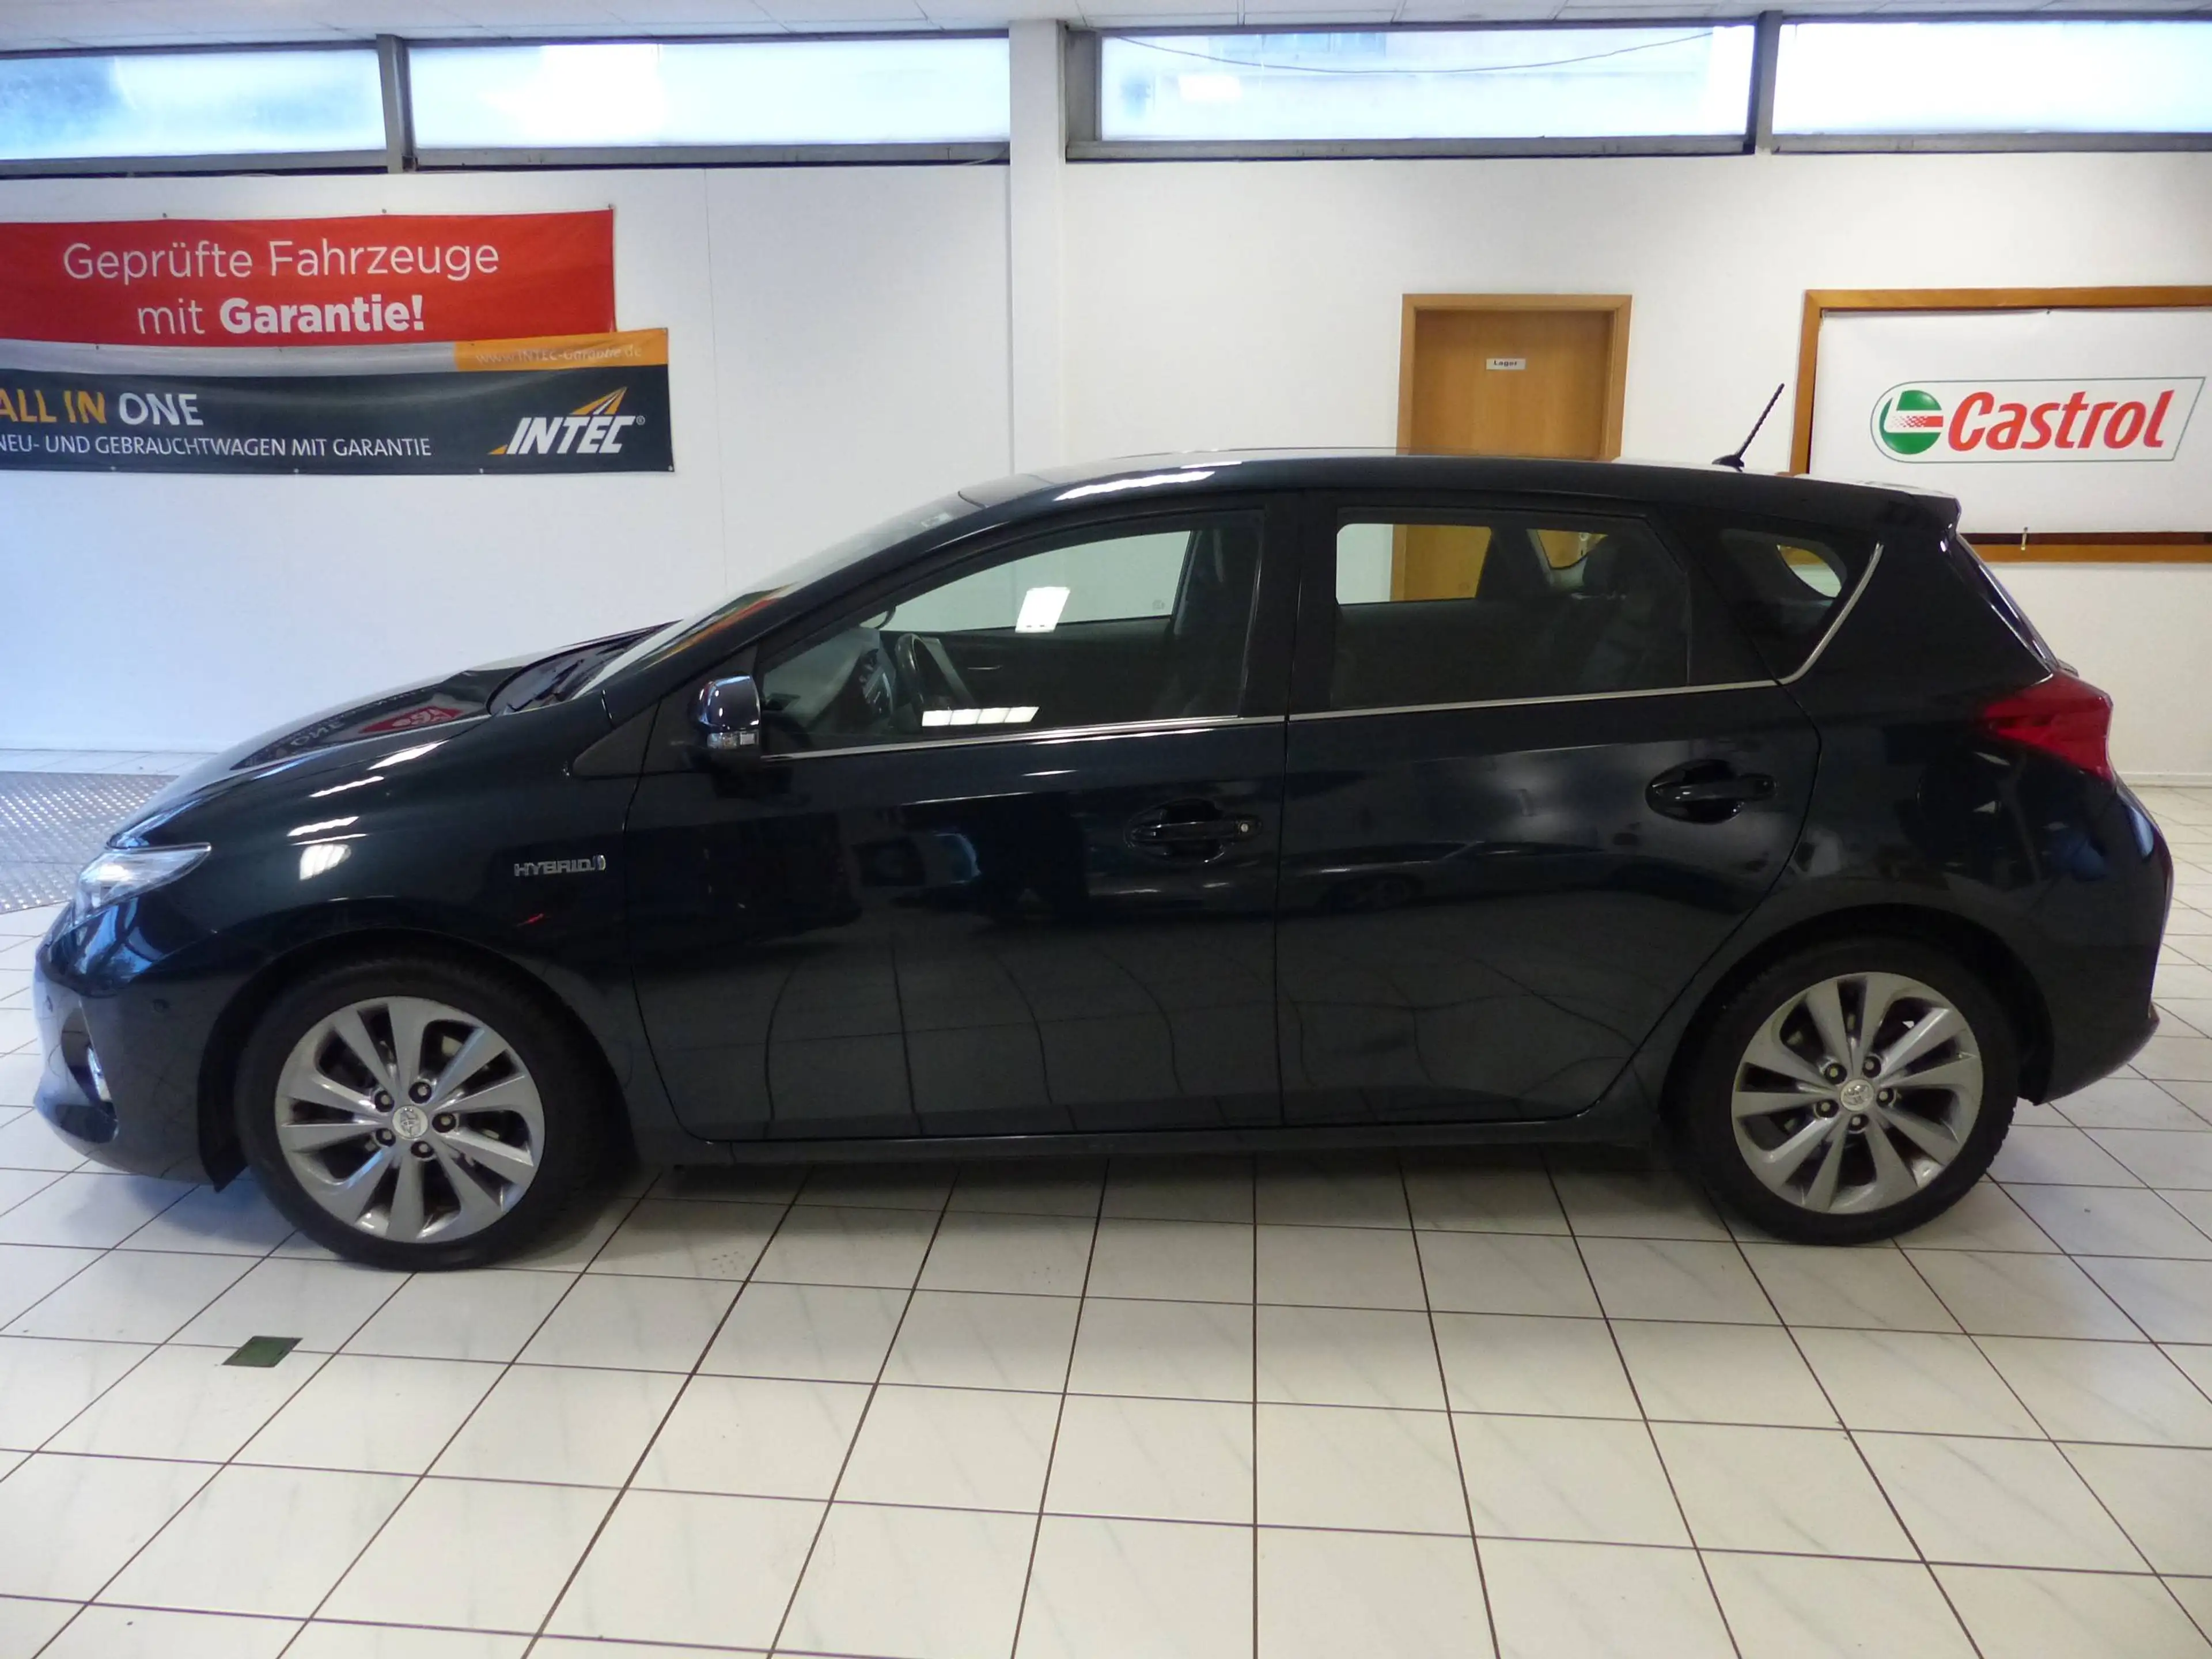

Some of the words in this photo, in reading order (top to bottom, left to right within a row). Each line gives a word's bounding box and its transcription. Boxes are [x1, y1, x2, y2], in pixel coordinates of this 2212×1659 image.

[63, 240, 253, 285] Geprüfte
[270, 237, 499, 281] Fahrzeuge
[138, 298, 205, 335] mit
[219, 294, 425, 334] Garantie!
[0, 388, 57, 422] ALL
[63, 391, 107, 423] IN
[119, 393, 204, 426] ONE
[1947, 389, 2175, 452] Castrol
[45, 435, 90, 454] UND
[95, 436, 286, 457] GEBRAUCHTWAGEN
[291, 438, 327, 456] MIT
[332, 438, 431, 457] GARANTIE
[514, 859, 591, 876] HYBRID
